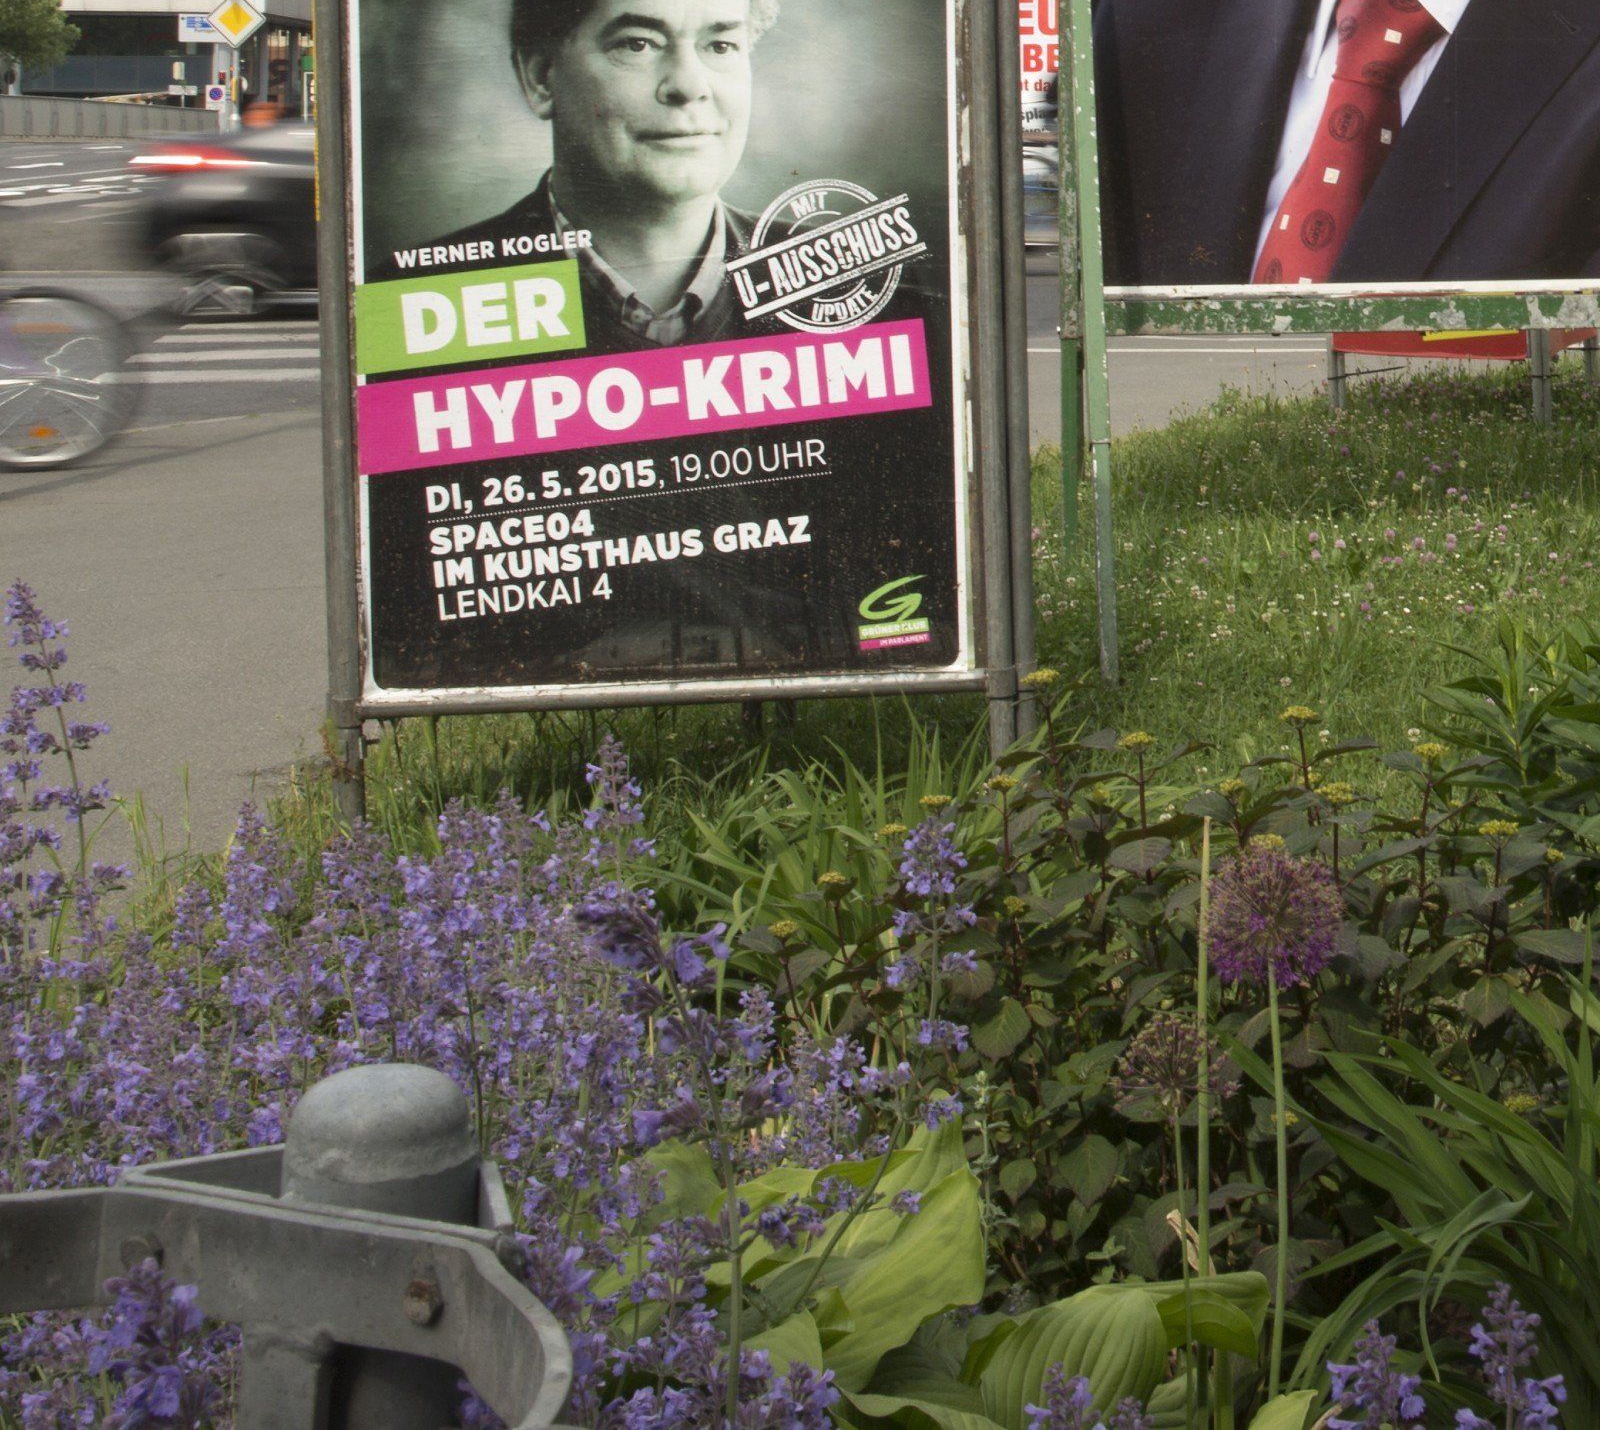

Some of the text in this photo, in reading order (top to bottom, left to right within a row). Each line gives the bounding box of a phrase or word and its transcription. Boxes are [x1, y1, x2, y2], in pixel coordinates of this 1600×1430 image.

[789, 191, 828, 219] MIT
[394, 229, 593, 268] WERNER KOGLER
[733, 207, 918, 309] U-AUSSCHUSS
[400, 277, 571, 354] DER
[811, 284, 880, 323] UPDATE
[413, 334, 915, 454] HYPO-KRIMI
[425, 482, 473, 515] DI,
[669, 447, 753, 483] 19.00
[758, 438, 827, 470] UHR
[429, 509, 595, 555] SPACE04
[432, 514, 812, 588] IM KUNSTHAUS GRAZ
[437, 573, 613, 621] LENDKAI 4
[889, 633, 929, 645] PARLAMENT
